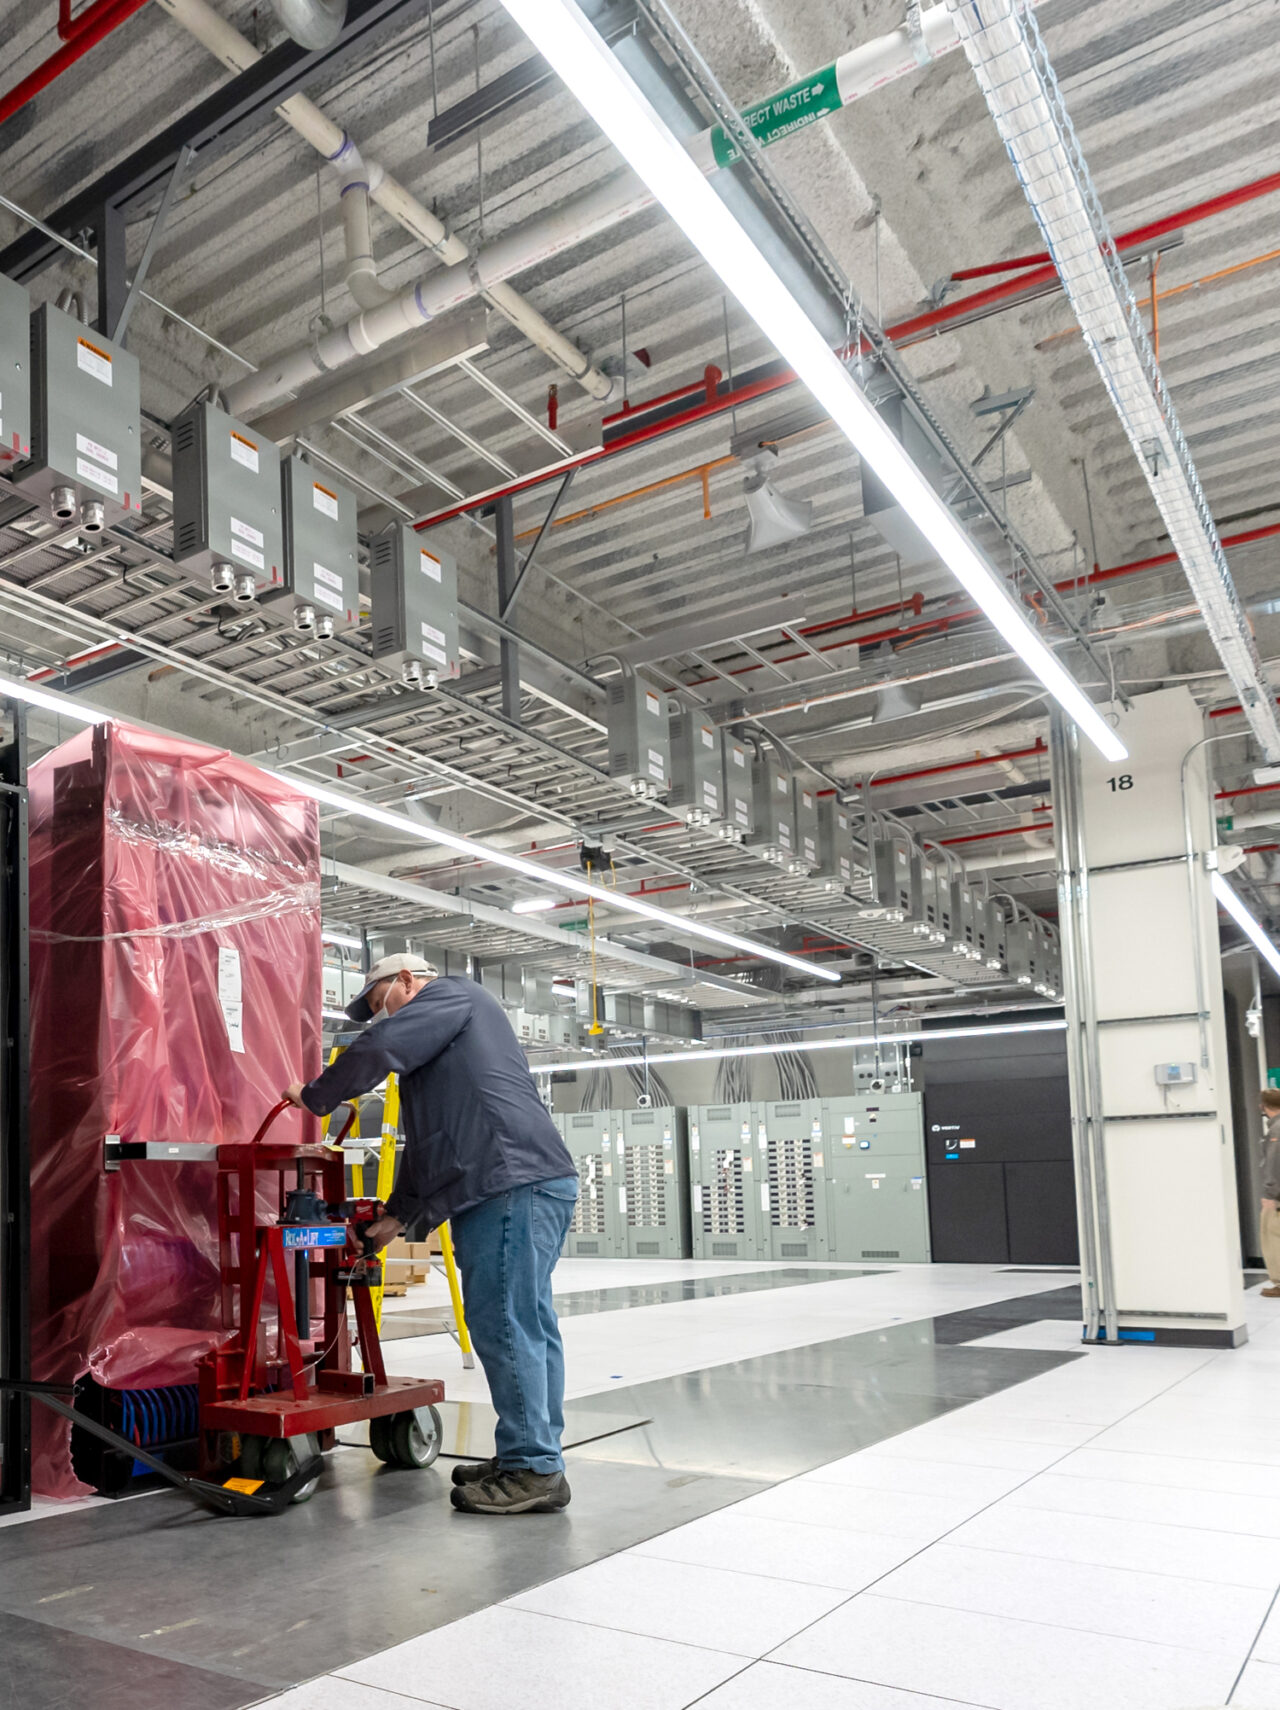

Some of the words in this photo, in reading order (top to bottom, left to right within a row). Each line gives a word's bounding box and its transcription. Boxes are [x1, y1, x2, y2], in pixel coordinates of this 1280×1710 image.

[773, 87, 812, 119] WASTE
[767, 112, 816, 142] INDIRECT
[1106, 774, 1134, 792] 18
